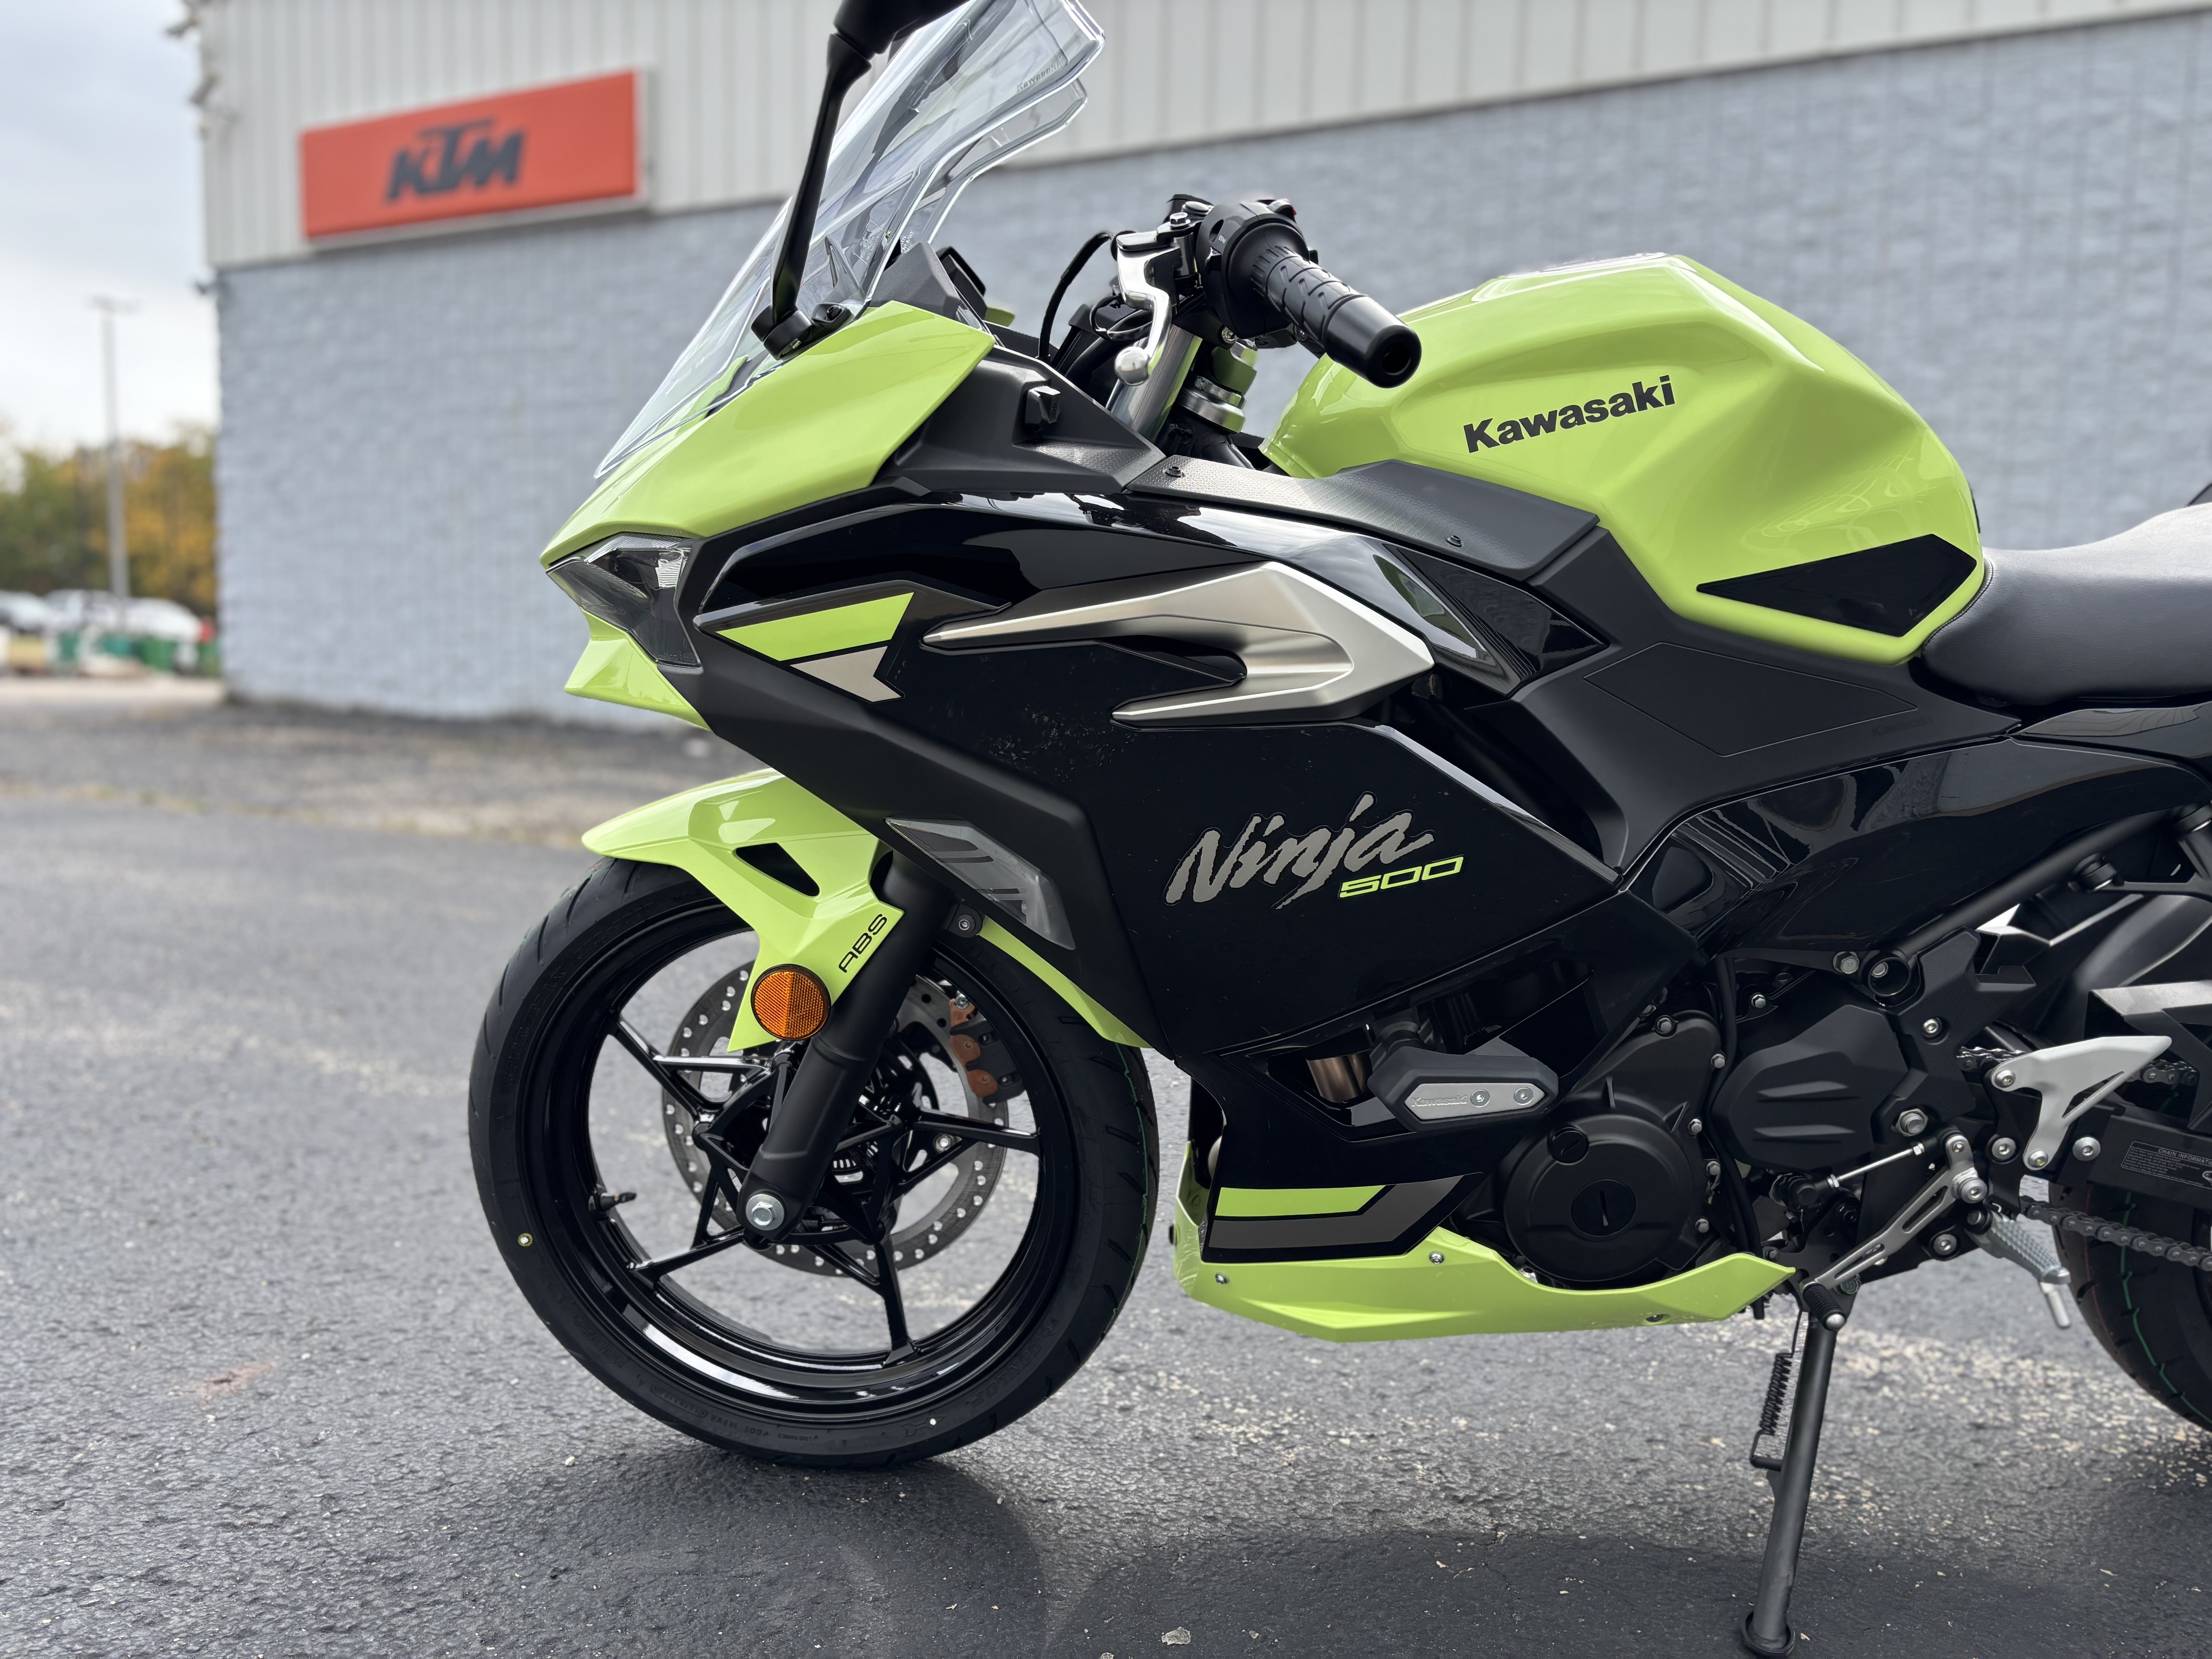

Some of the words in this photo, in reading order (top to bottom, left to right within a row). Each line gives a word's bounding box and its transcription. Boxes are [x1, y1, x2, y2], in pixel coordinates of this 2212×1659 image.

[385, 117, 524, 201] KTM
[1463, 374, 1675, 453] Kawasaki
[1165, 794, 1434, 910] Ninja
[1339, 856, 1464, 898] 500
[838, 914, 887, 973] ABS
[1411, 1094, 1468, 1107] Kawasaki
[972, 1336, 1043, 1407] DUNLOP
